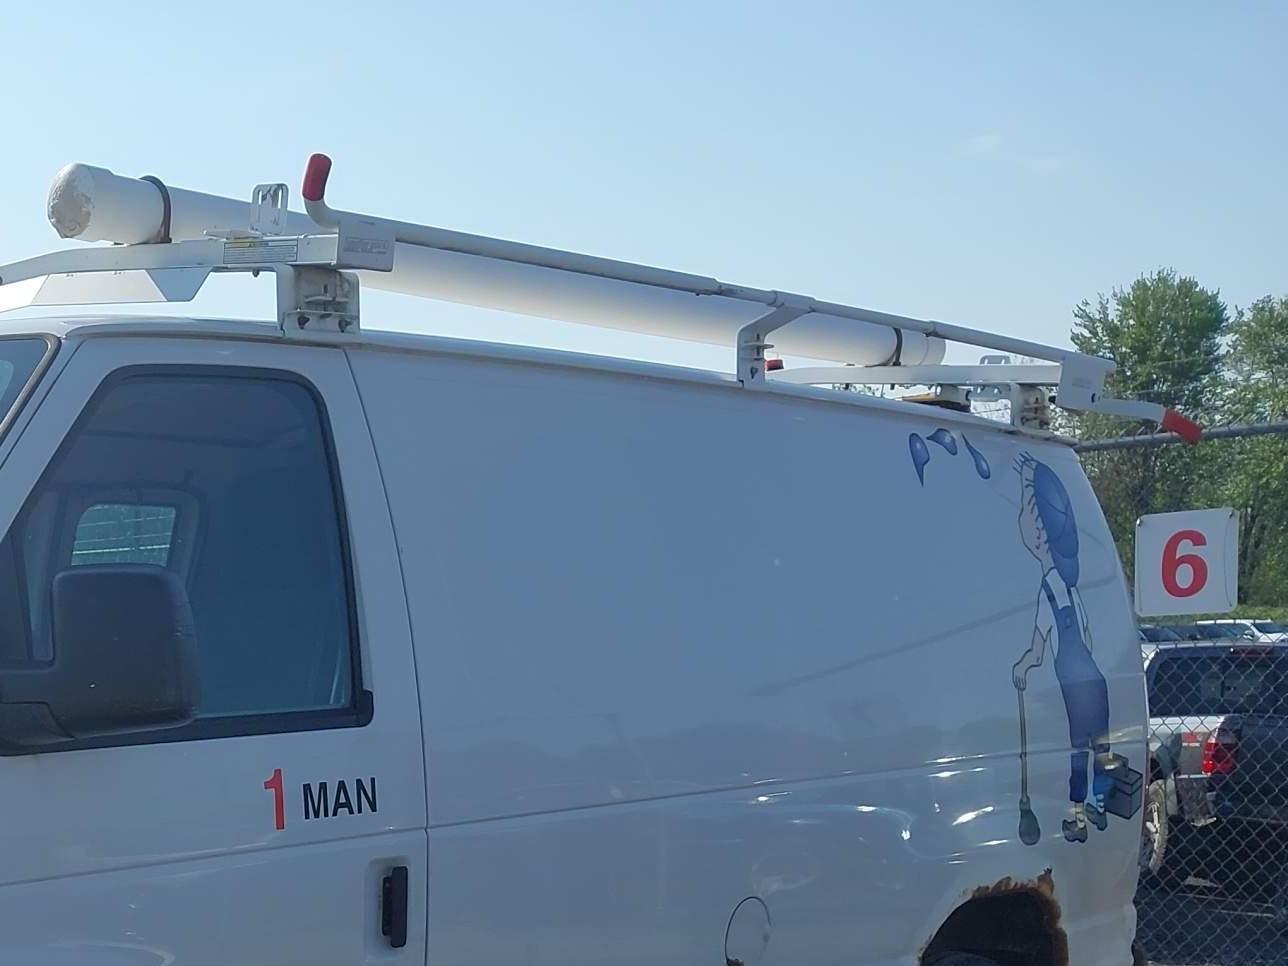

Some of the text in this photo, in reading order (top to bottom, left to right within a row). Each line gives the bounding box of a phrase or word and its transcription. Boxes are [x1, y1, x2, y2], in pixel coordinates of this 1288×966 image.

[1162, 530, 1208, 597] 6
[264, 768, 377, 830] 1 MAN
